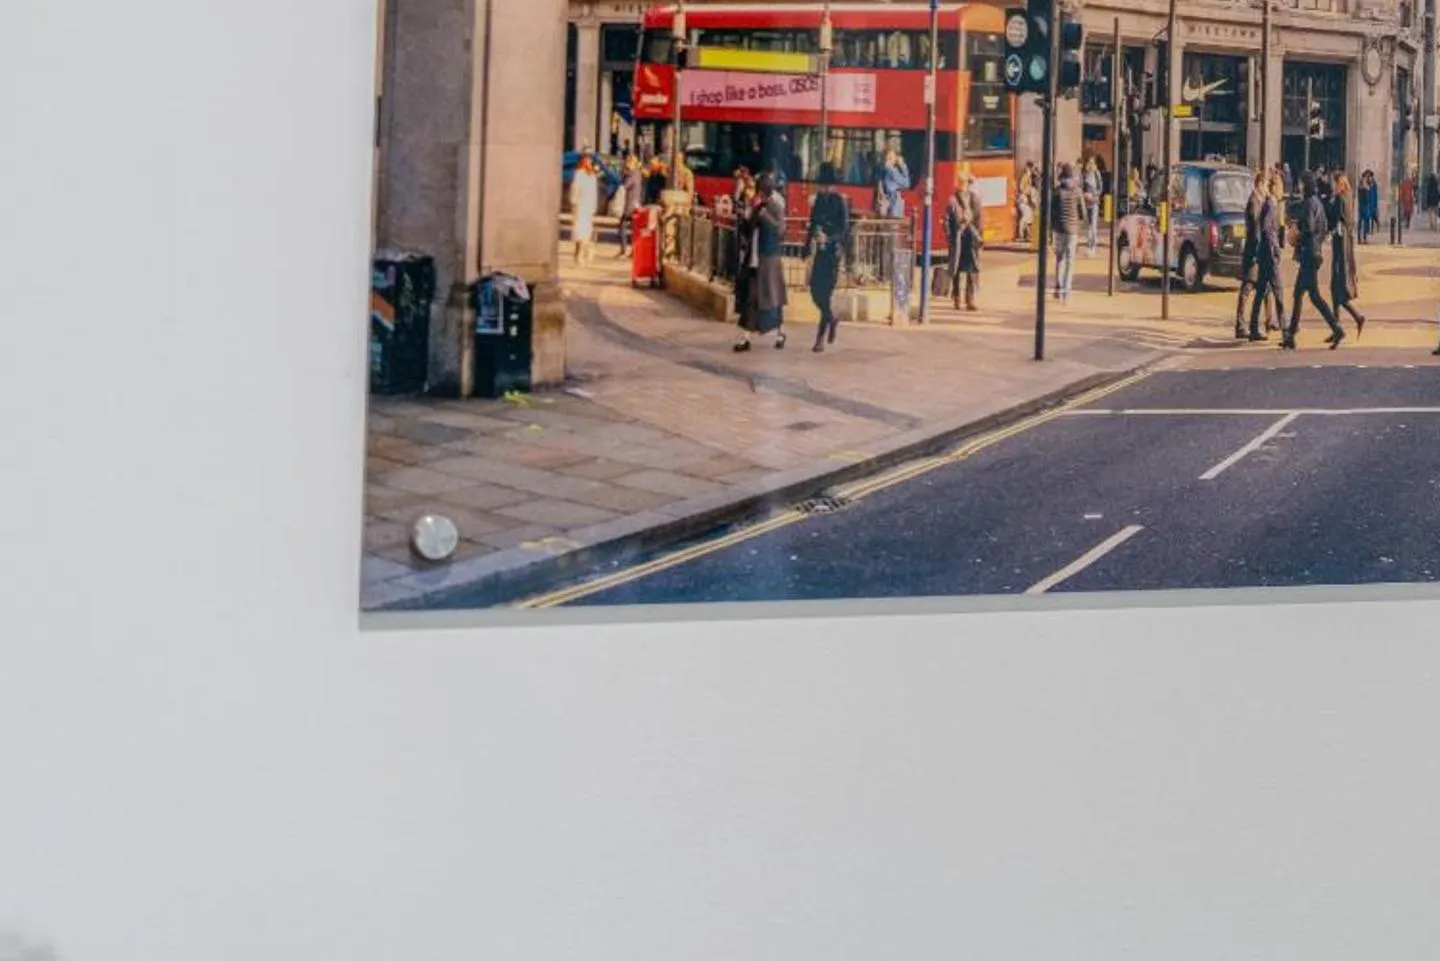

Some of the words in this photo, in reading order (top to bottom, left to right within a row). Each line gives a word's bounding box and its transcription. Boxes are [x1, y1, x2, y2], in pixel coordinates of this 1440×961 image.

[698, 90, 723, 107] shop
[724, 85, 745, 101] like
[746, 91, 756, 99] a
